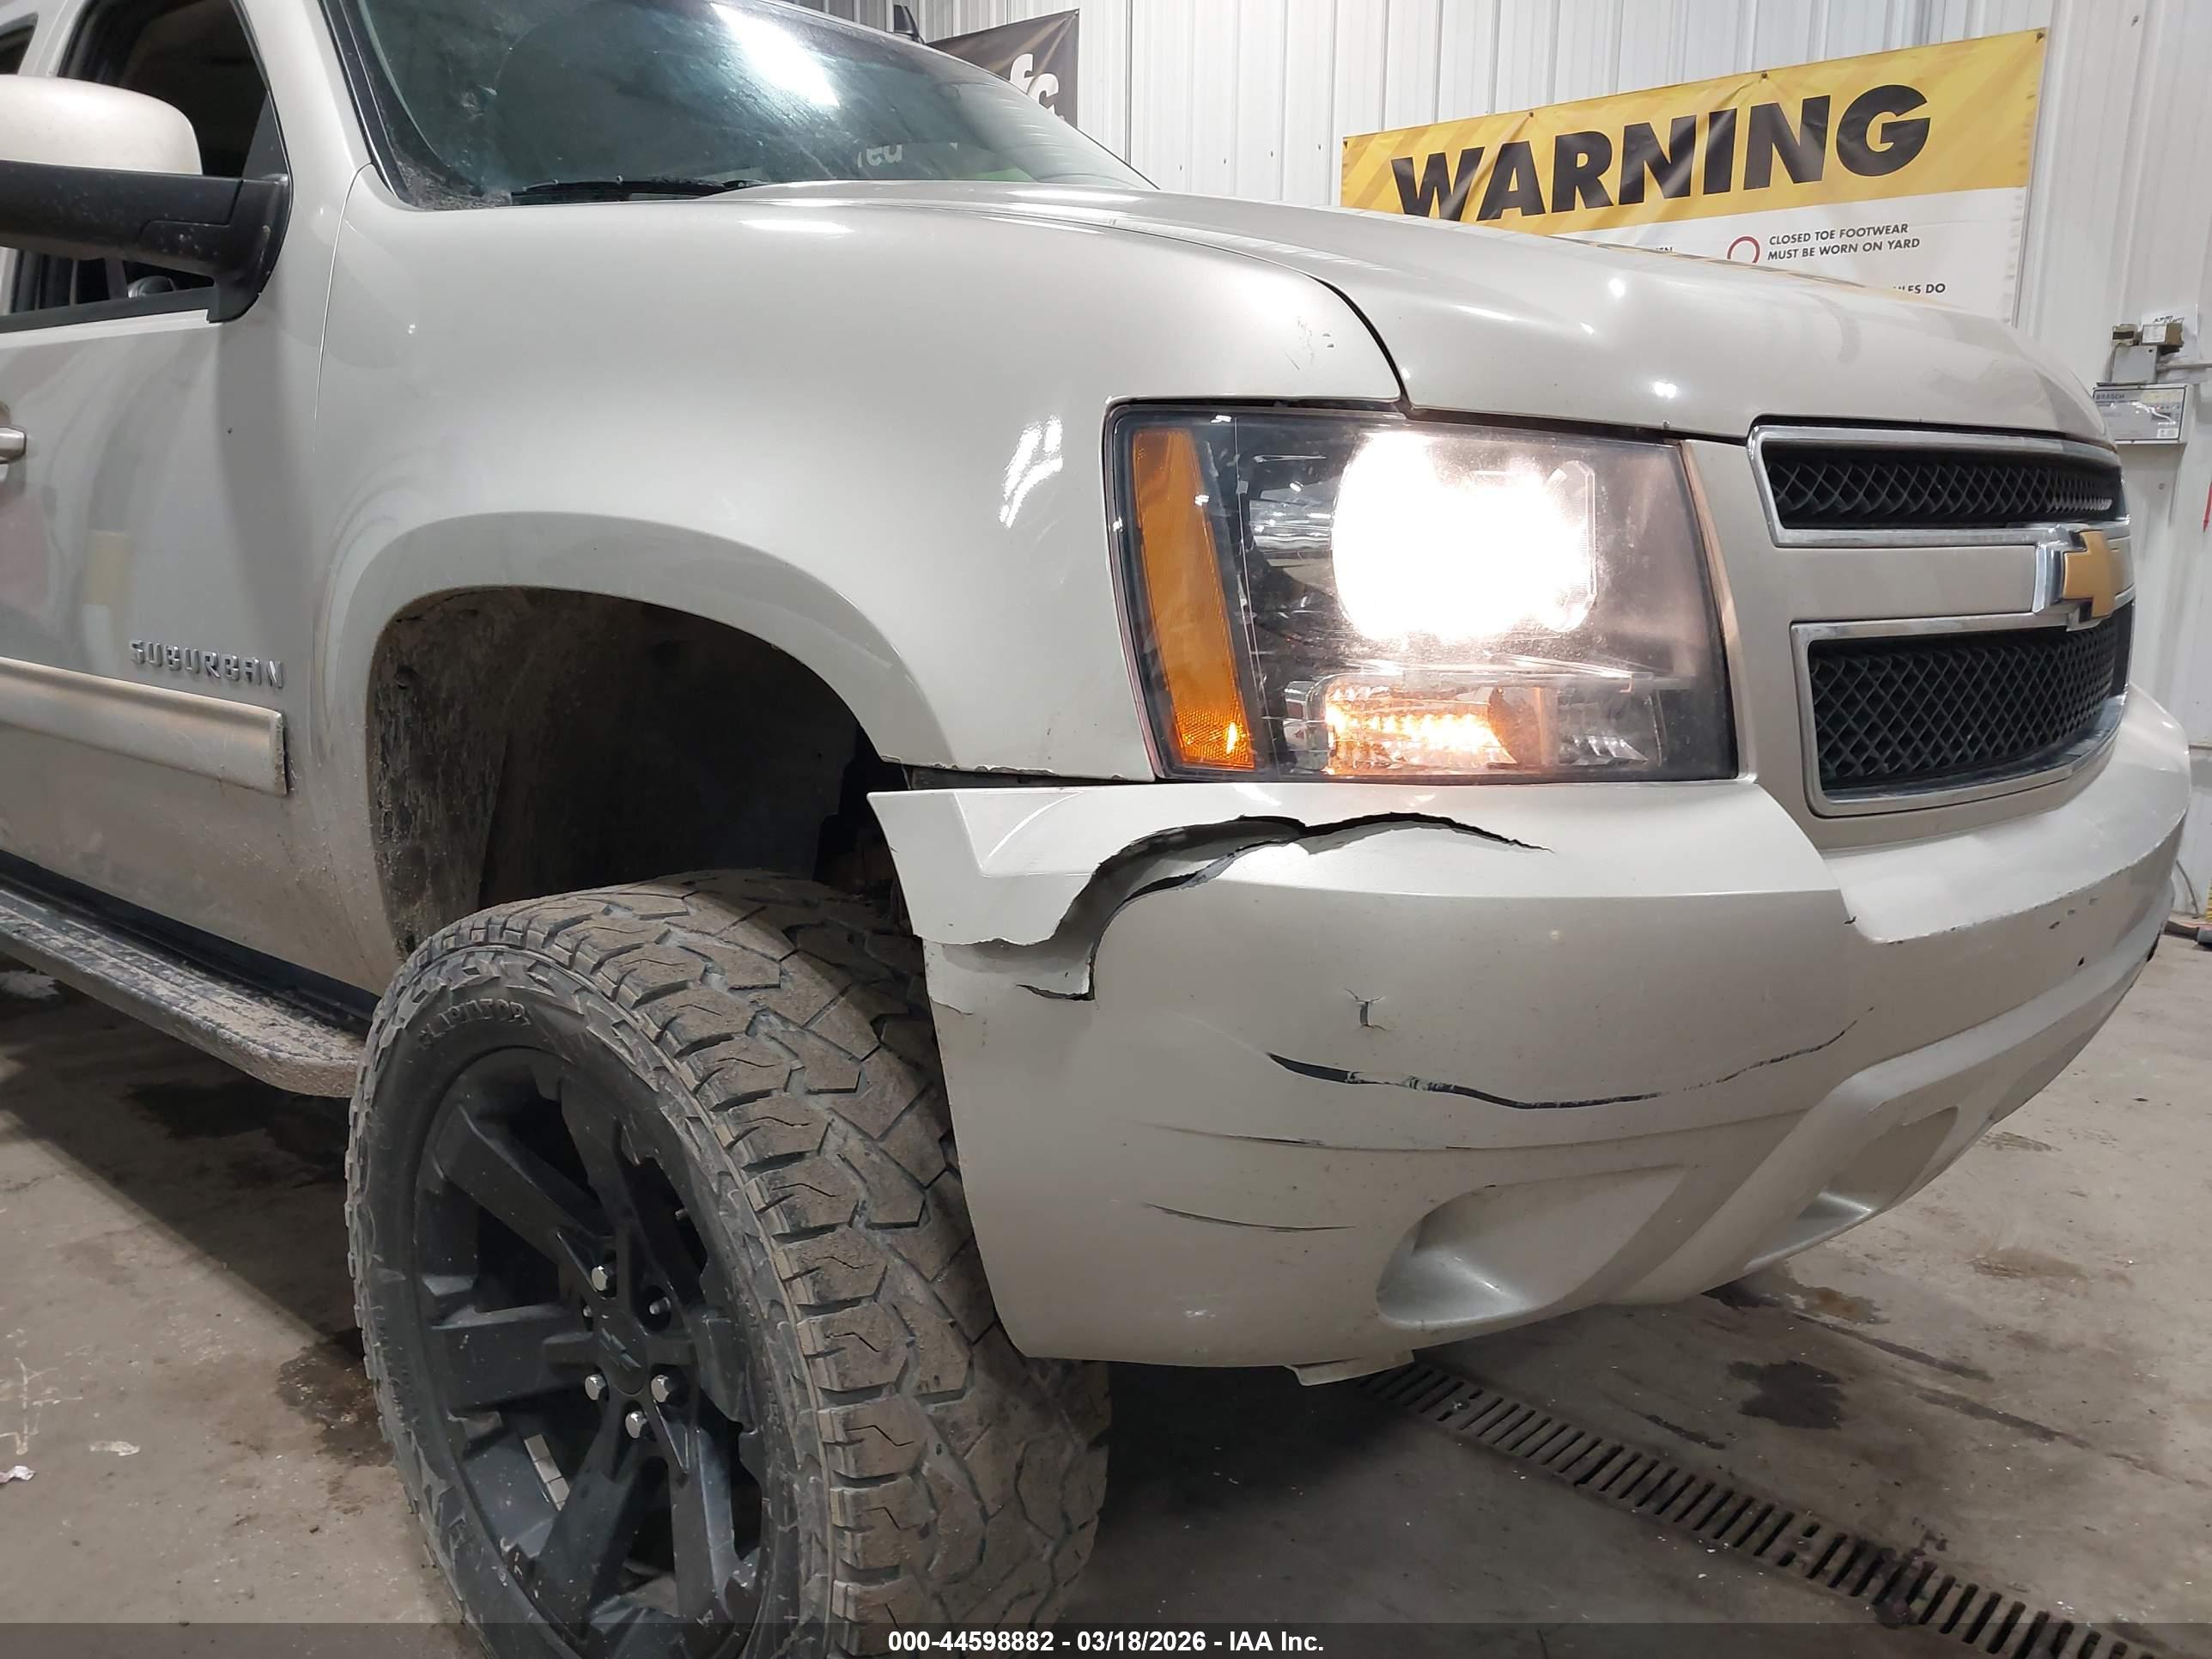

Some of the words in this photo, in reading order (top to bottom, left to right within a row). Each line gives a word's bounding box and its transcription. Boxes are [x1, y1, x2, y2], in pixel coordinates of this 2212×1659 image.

[1391, 84, 1931, 222] WARNING
[1769, 233, 1811, 246] CLOSED
[1814, 230, 1836, 240] TOE
[1838, 223, 1909, 239] FOOTWEAR
[1767, 249, 1798, 260] MUST
[1802, 247, 1815, 258] BE
[1819, 244, 1858, 256] WORN
[1862, 241, 1883, 252] ON
[1887, 238, 1920, 250] YARD
[1925, 283, 1946, 294] DO
[131, 640, 284, 689] SUBURBAN
